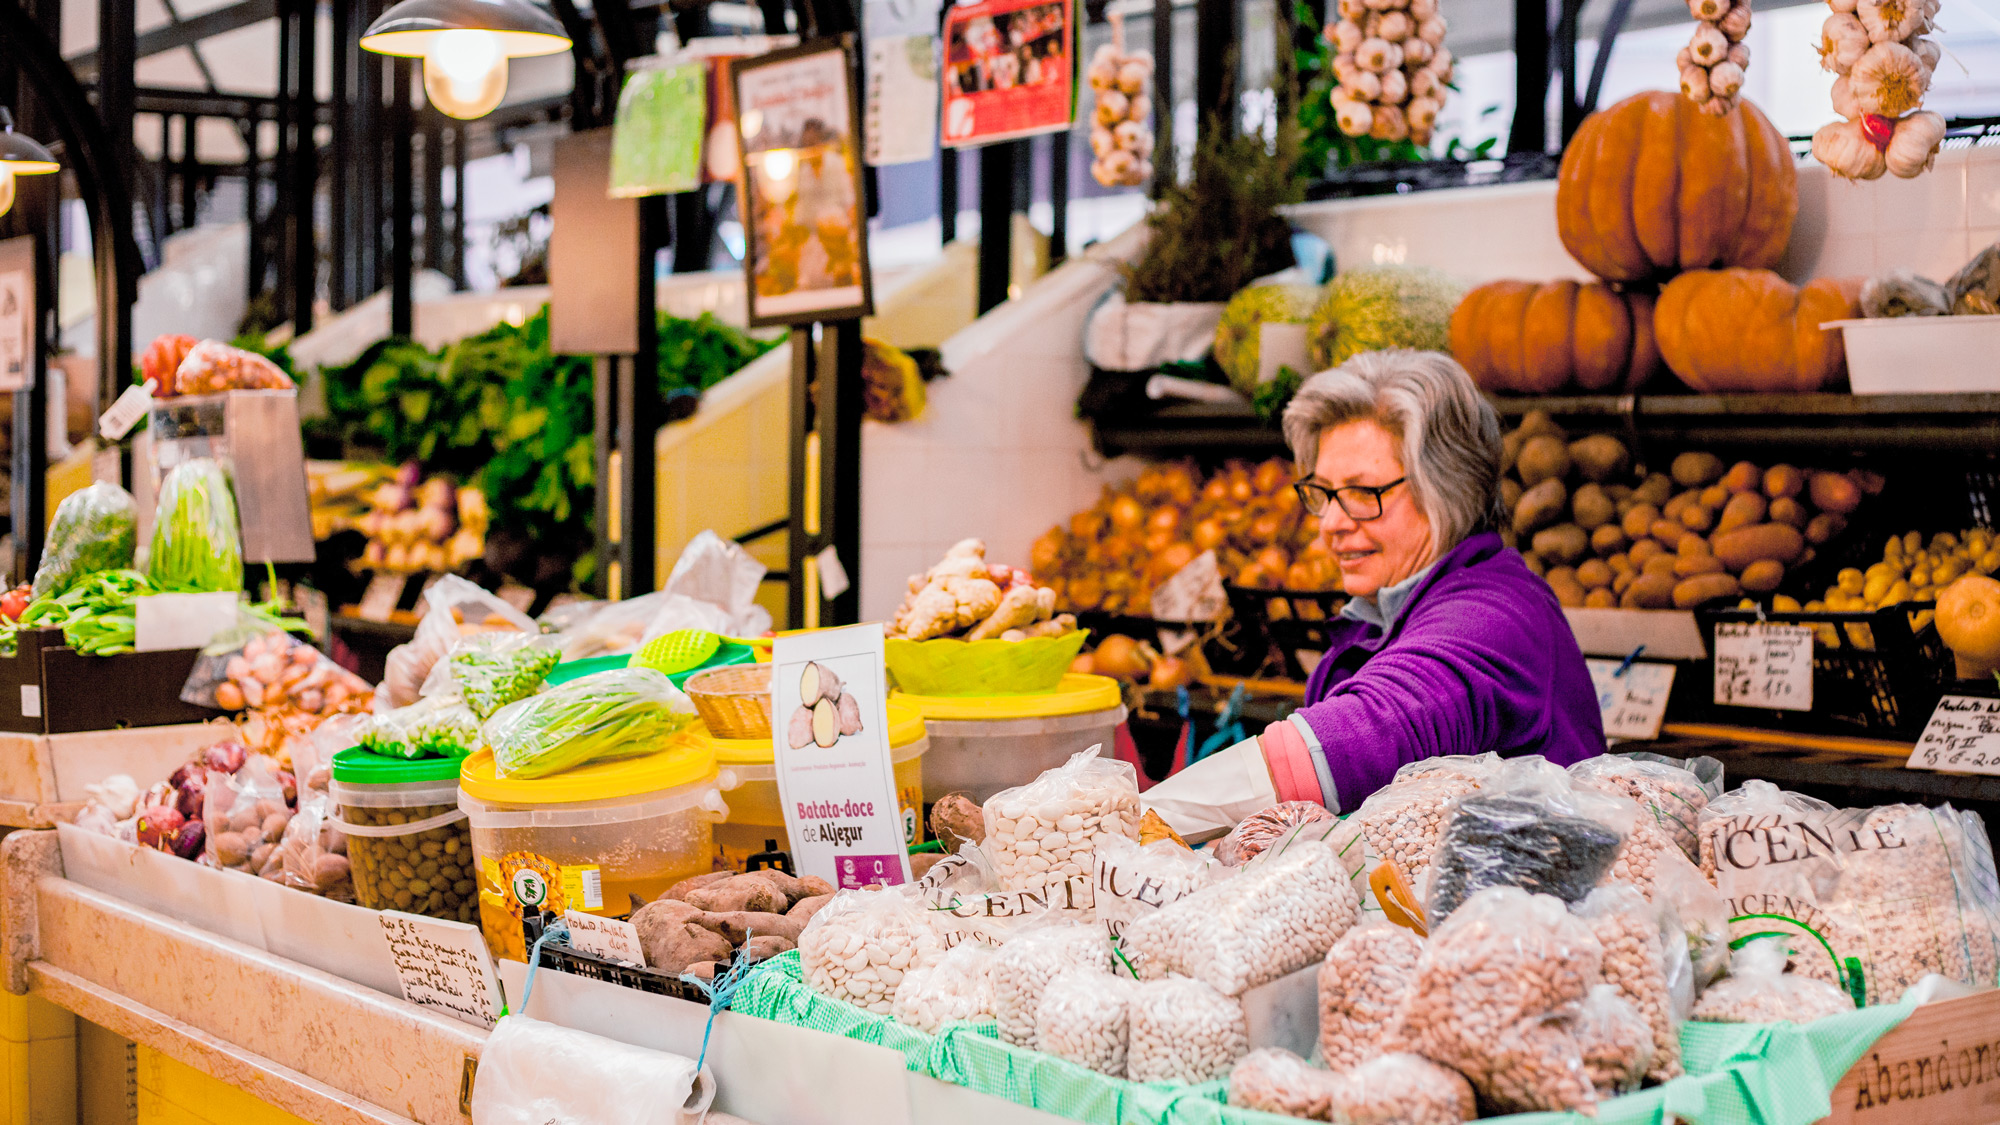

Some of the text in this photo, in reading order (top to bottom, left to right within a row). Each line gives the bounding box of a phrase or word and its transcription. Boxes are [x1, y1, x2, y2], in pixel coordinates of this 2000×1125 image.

[797, 799, 875, 820] Batata-doce
[803, 822, 863, 847] de Aljezur
